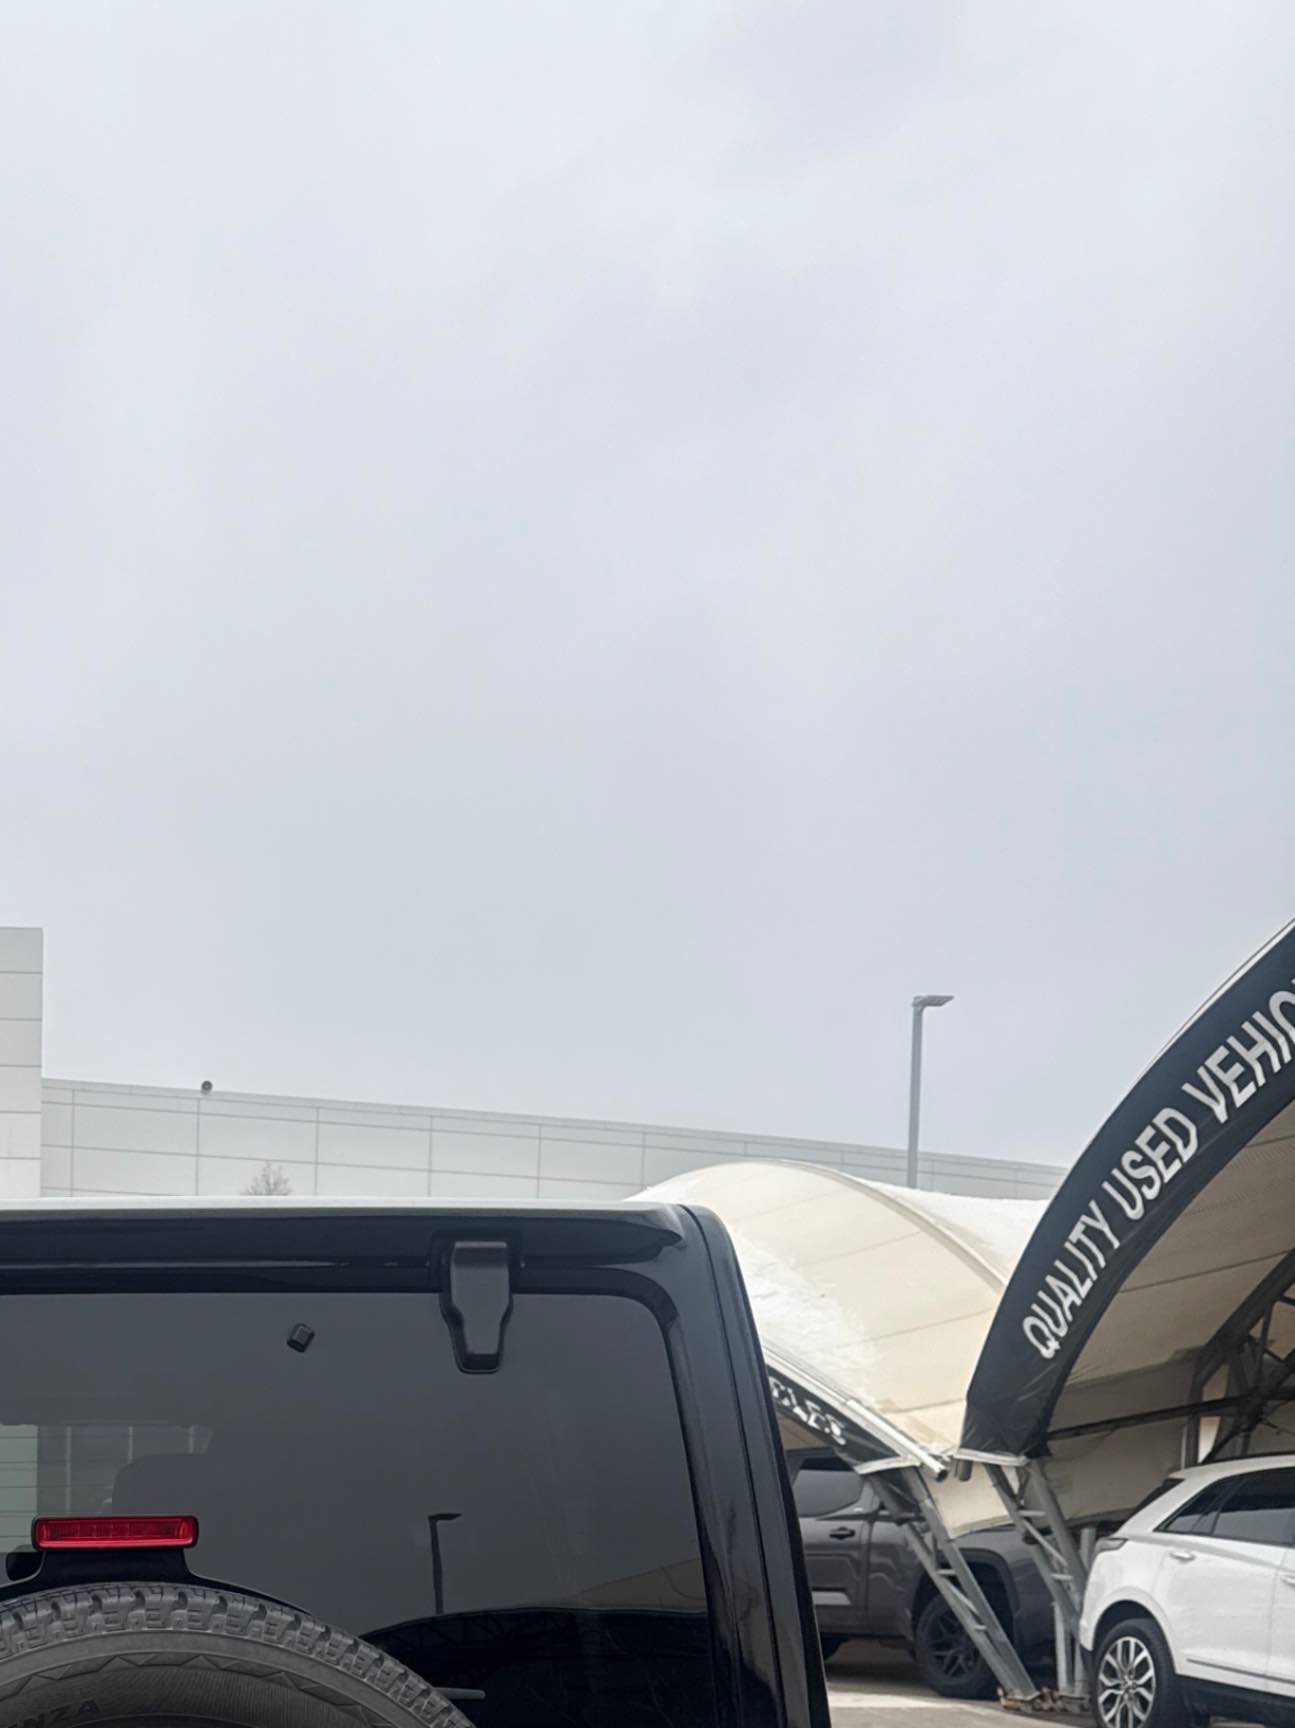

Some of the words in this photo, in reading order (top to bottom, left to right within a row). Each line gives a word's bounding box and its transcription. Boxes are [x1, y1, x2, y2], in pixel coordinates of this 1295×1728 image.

[1023, 1201, 1122, 1360] QUALITY
[1103, 1107, 1199, 1220] USED
[1182, 978, 1295, 1124] VEHIC
